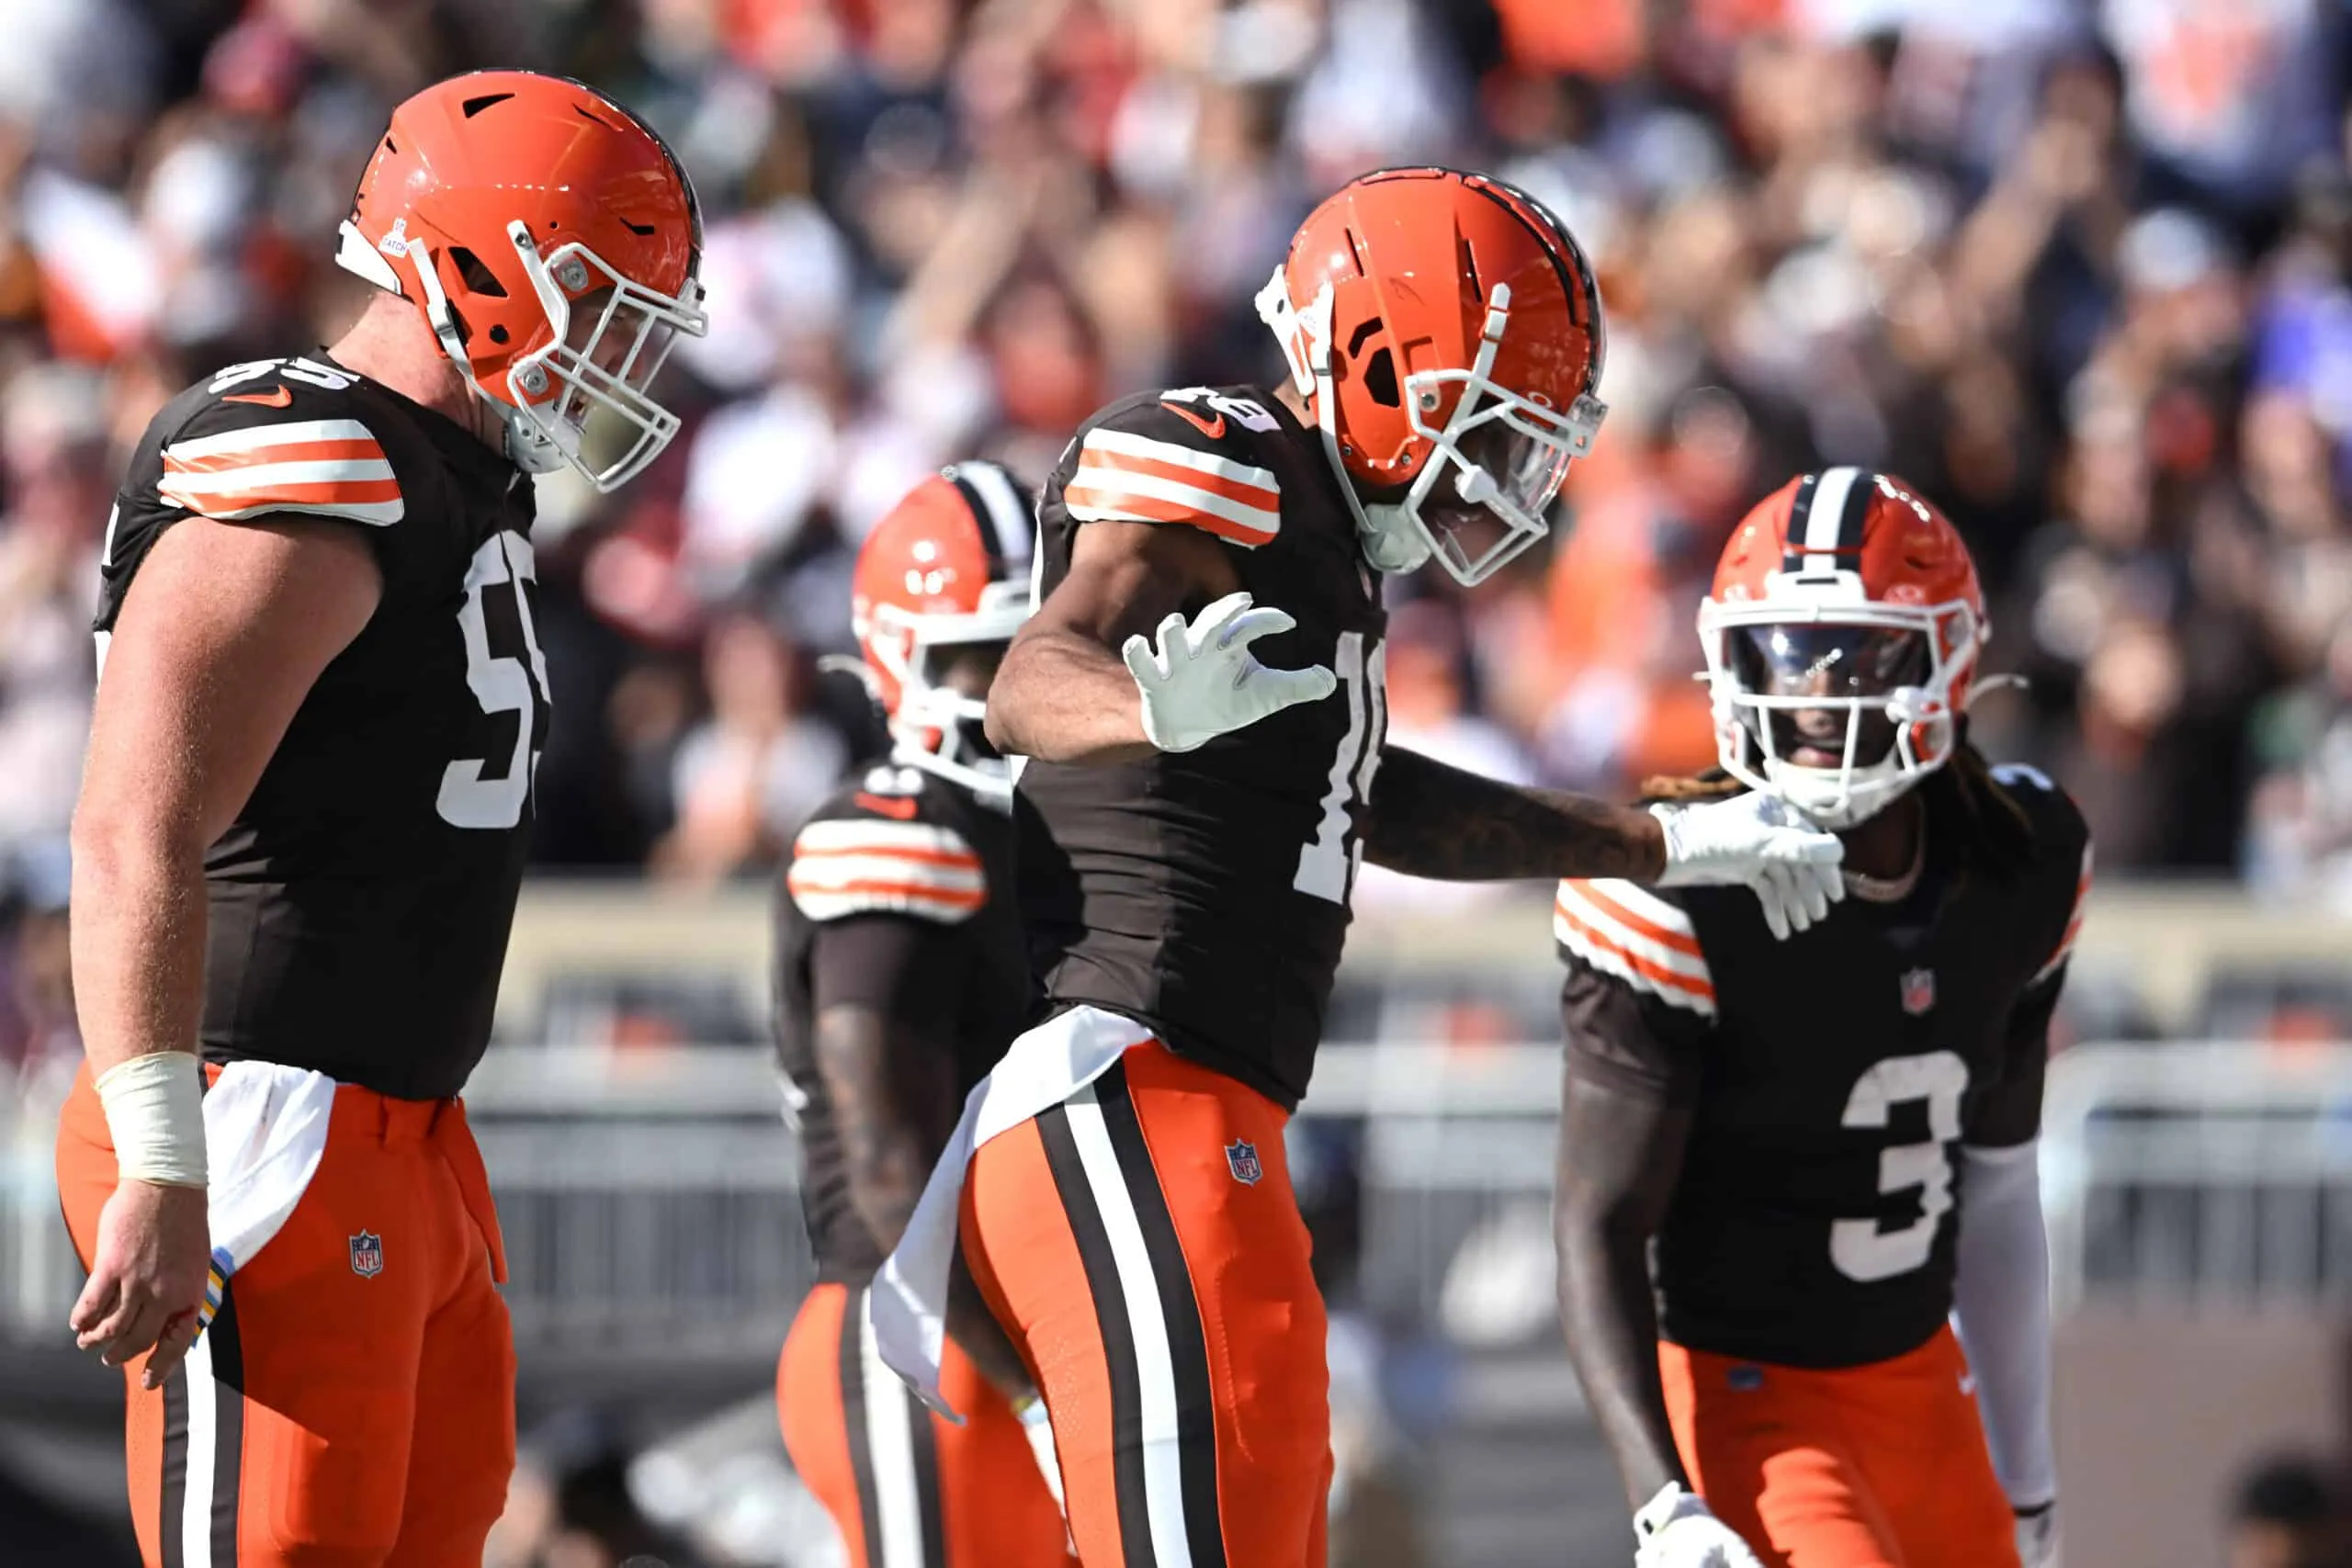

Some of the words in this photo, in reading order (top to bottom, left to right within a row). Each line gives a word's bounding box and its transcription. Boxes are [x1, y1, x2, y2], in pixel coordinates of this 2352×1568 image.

[1235, 1158, 1259, 1177] NFL
[1829, 1049, 1970, 1282] 3
[355, 1249, 379, 1269] NFL
